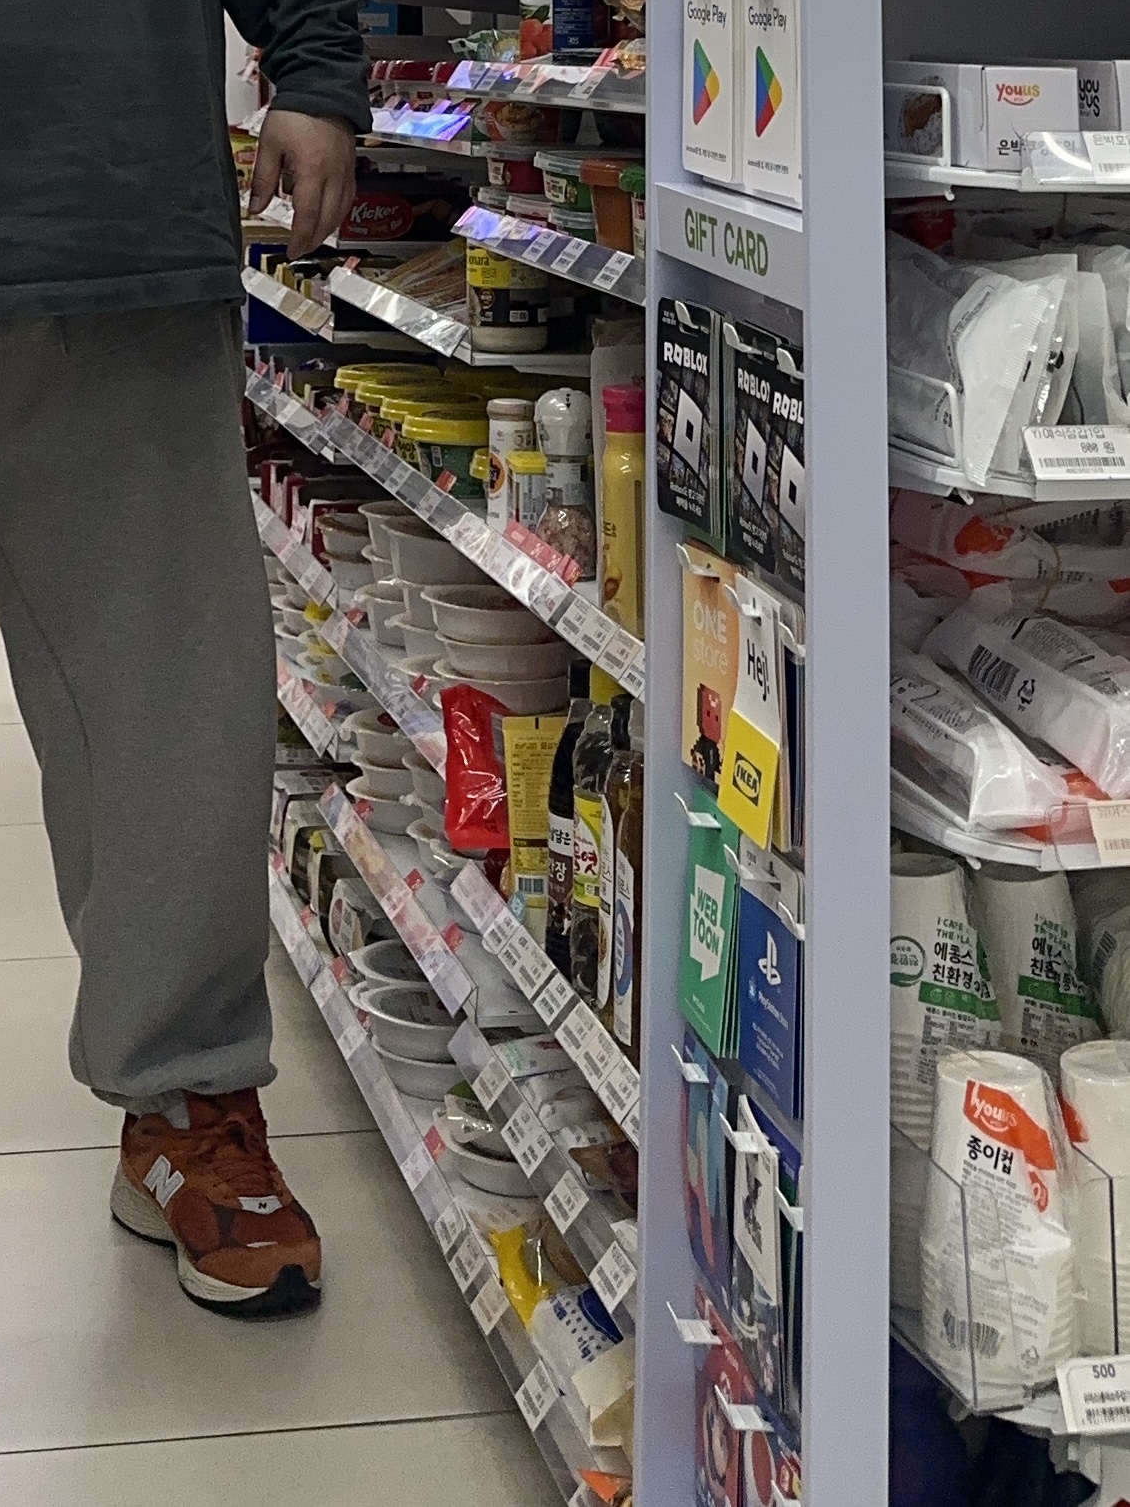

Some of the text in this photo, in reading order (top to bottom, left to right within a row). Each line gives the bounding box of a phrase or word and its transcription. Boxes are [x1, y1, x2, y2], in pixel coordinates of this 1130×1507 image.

[687, 0, 728, 29] Google Play
[748, 5, 788, 34] Google Play
[995, 83, 1041, 102] youus
[349, 200, 399, 222] Kicker
[684, 207, 769, 277] GIFT CARD
[663, 341, 708, 377] ROBLOX
[772, 391, 804, 426] ROBL
[692, 599, 727, 645] ONE
[693, 637, 728, 676] store
[746, 637, 771, 702] Hej!
[735, 763, 759, 793] IKEA
[696, 886, 719, 928] WEB
[692, 909, 720, 957] TOON
[966, 1134, 1014, 1176] 종이컵
[1091, 1364, 1117, 1379] 500
